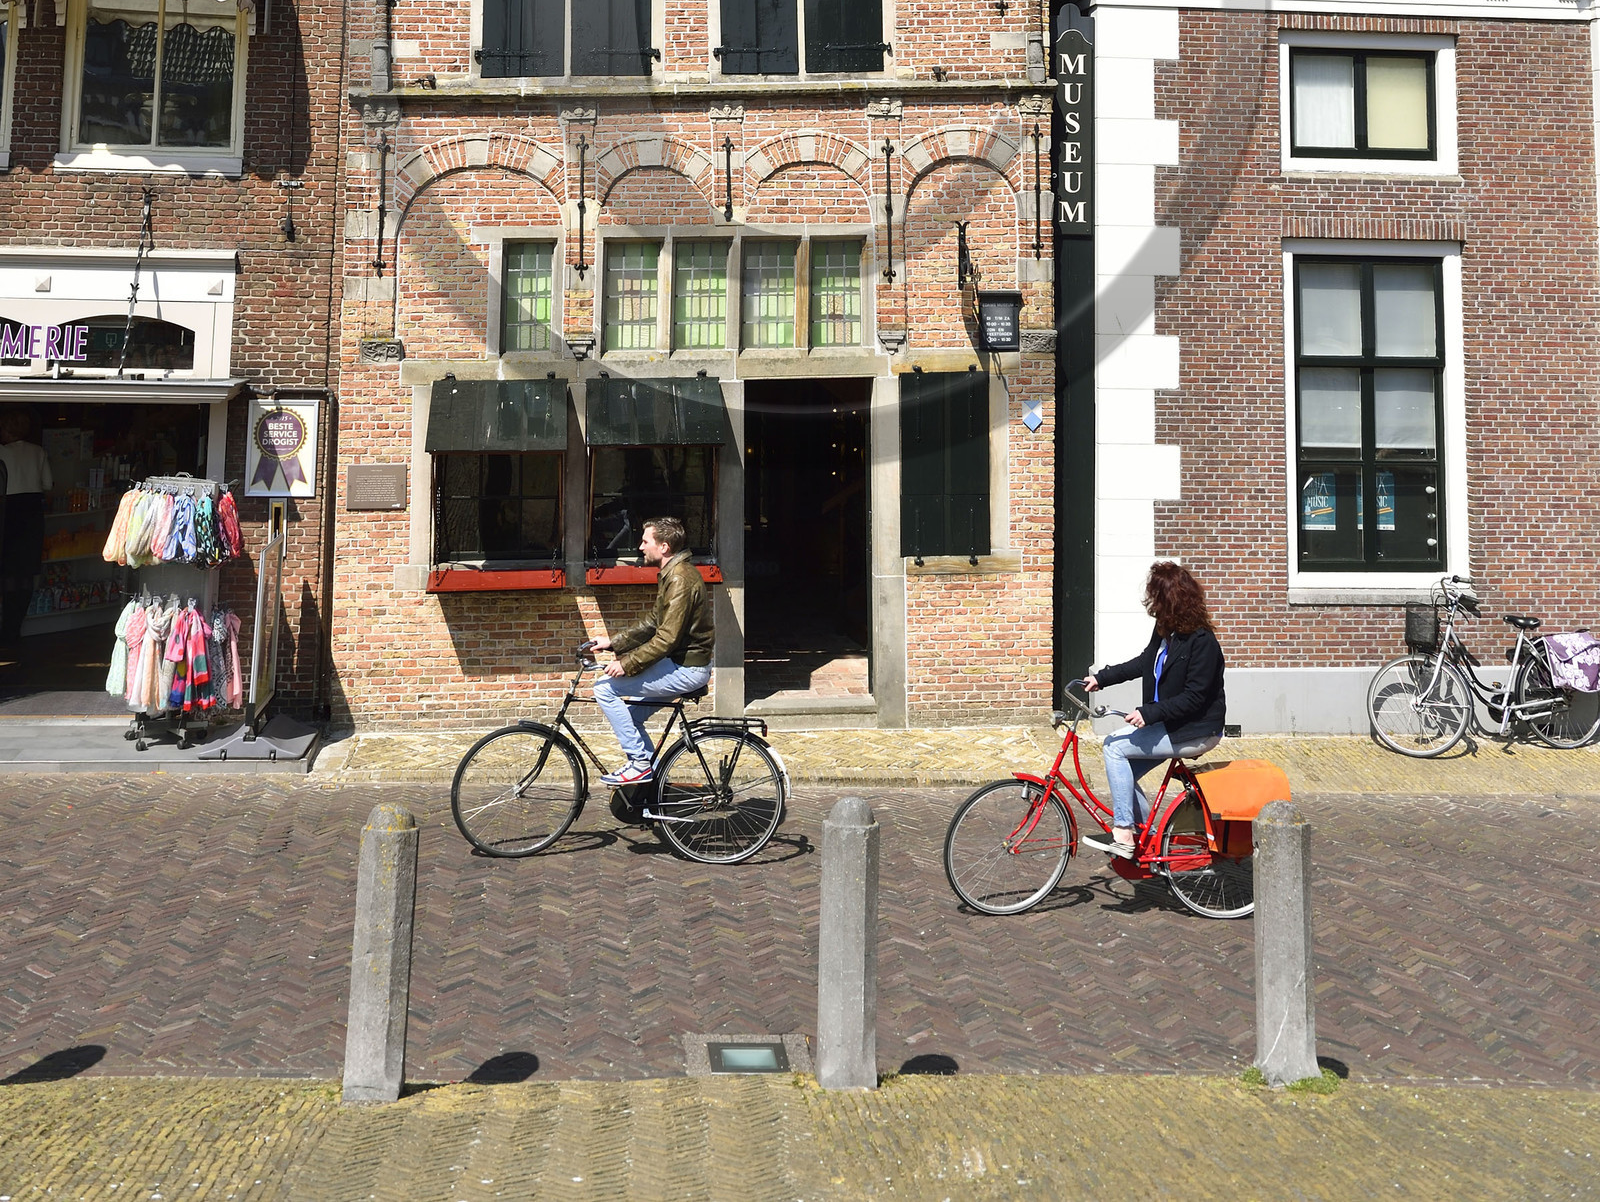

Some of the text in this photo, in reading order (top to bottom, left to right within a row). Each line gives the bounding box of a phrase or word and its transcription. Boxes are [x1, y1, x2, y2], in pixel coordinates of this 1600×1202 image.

[1059, 53, 1087, 223] MUSEUM
[0, 323, 89, 361] MERIE
[263, 430, 298, 438] SERVICE
[262, 438, 299, 446] DROGIST
[1307, 495, 1329, 508] MUSIC
